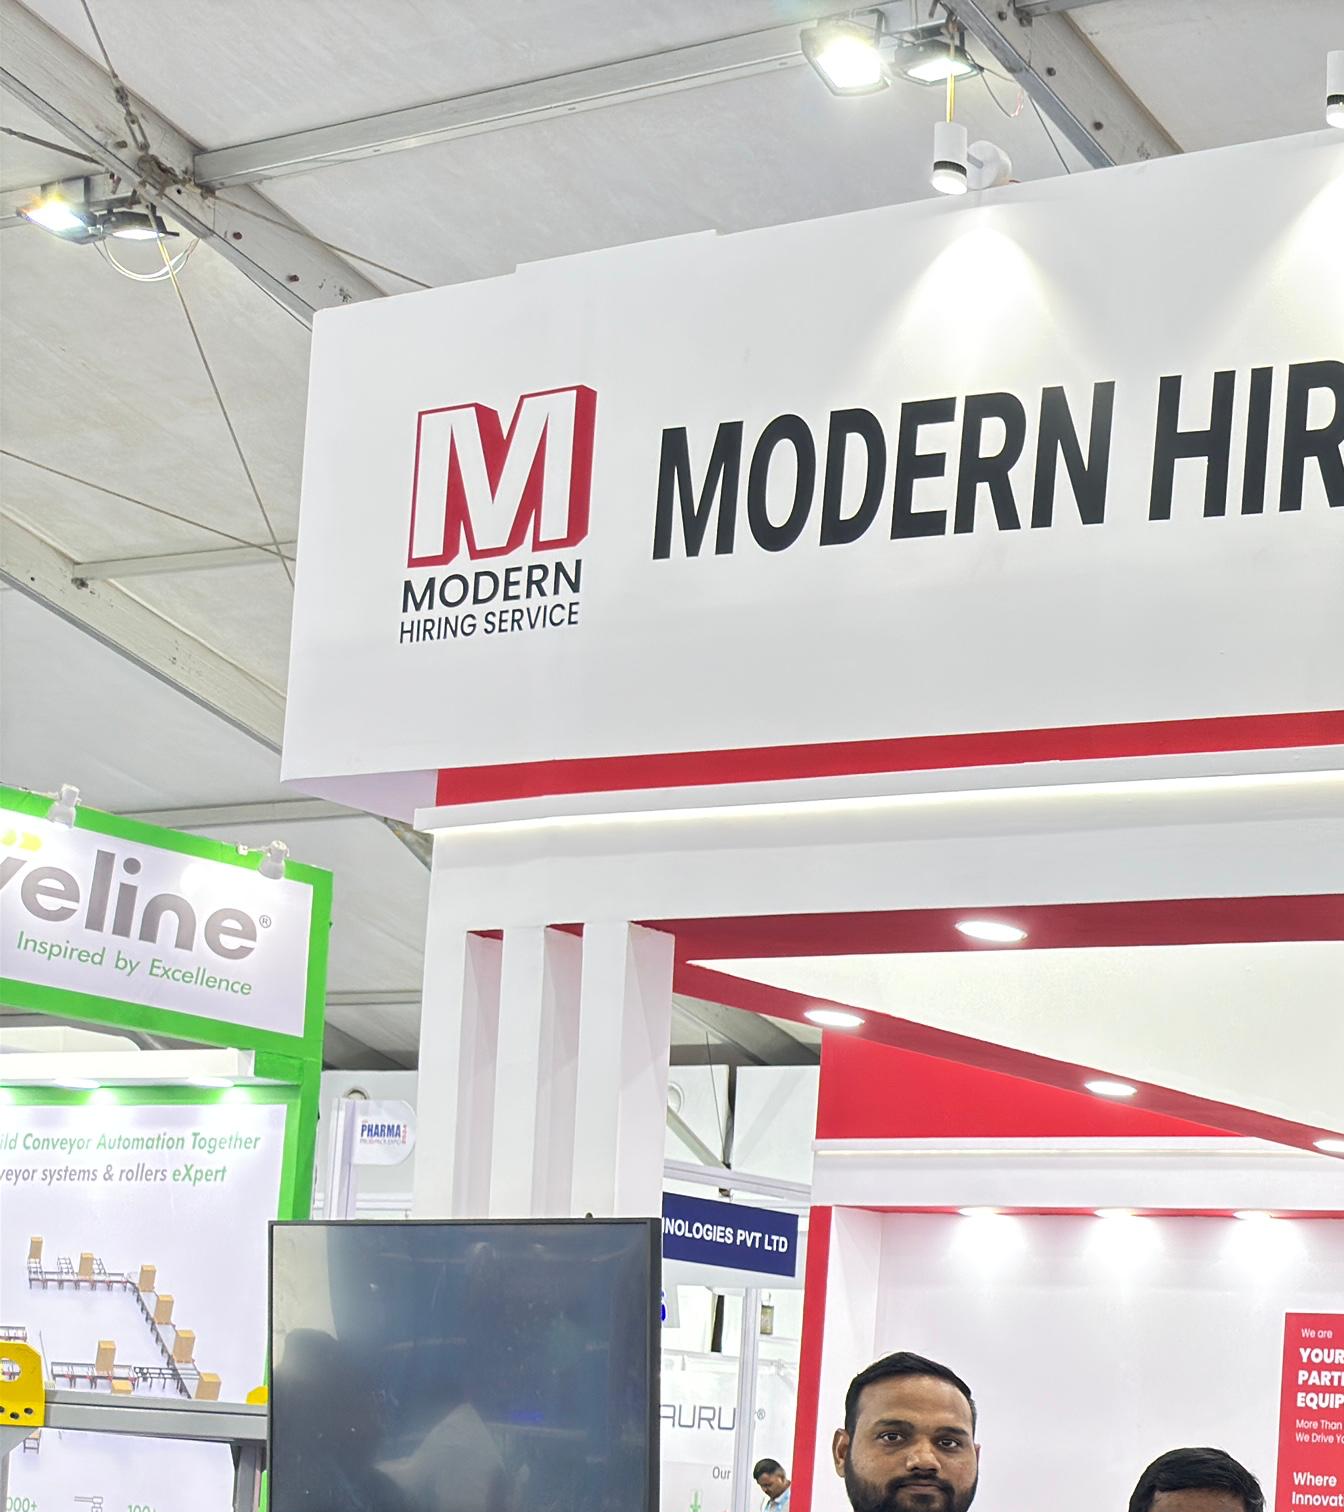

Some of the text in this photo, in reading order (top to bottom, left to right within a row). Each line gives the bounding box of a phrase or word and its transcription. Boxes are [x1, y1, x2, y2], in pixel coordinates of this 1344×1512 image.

[652, 381, 1116, 560] MODERN
[402, 559, 582, 613] MODERN
[400, 602, 579, 643] HIRING SERVICE
[16, 931, 252, 996] Inspired by Excellence
[361, 1124, 401, 1138] PHARMA
[23, 1131, 261, 1155] Conveyor Automation Together
[41, 1163, 227, 1186] systems & rollers eXpert
[662, 1217, 788, 1252] NOLOGIES PVT LTD
[1301, 1328, 1333, 1339] We are
[1300, 1348, 1344, 1364] YOUR
[1296, 1419, 1318, 1430] More
[1320, 1420, 1342, 1430] Than
[1295, 1432, 1310, 1443] We
[1312, 1433, 1334, 1444] Drive
[712, 1466, 732, 1480] Our
[1293, 1472, 1337, 1487] Where
